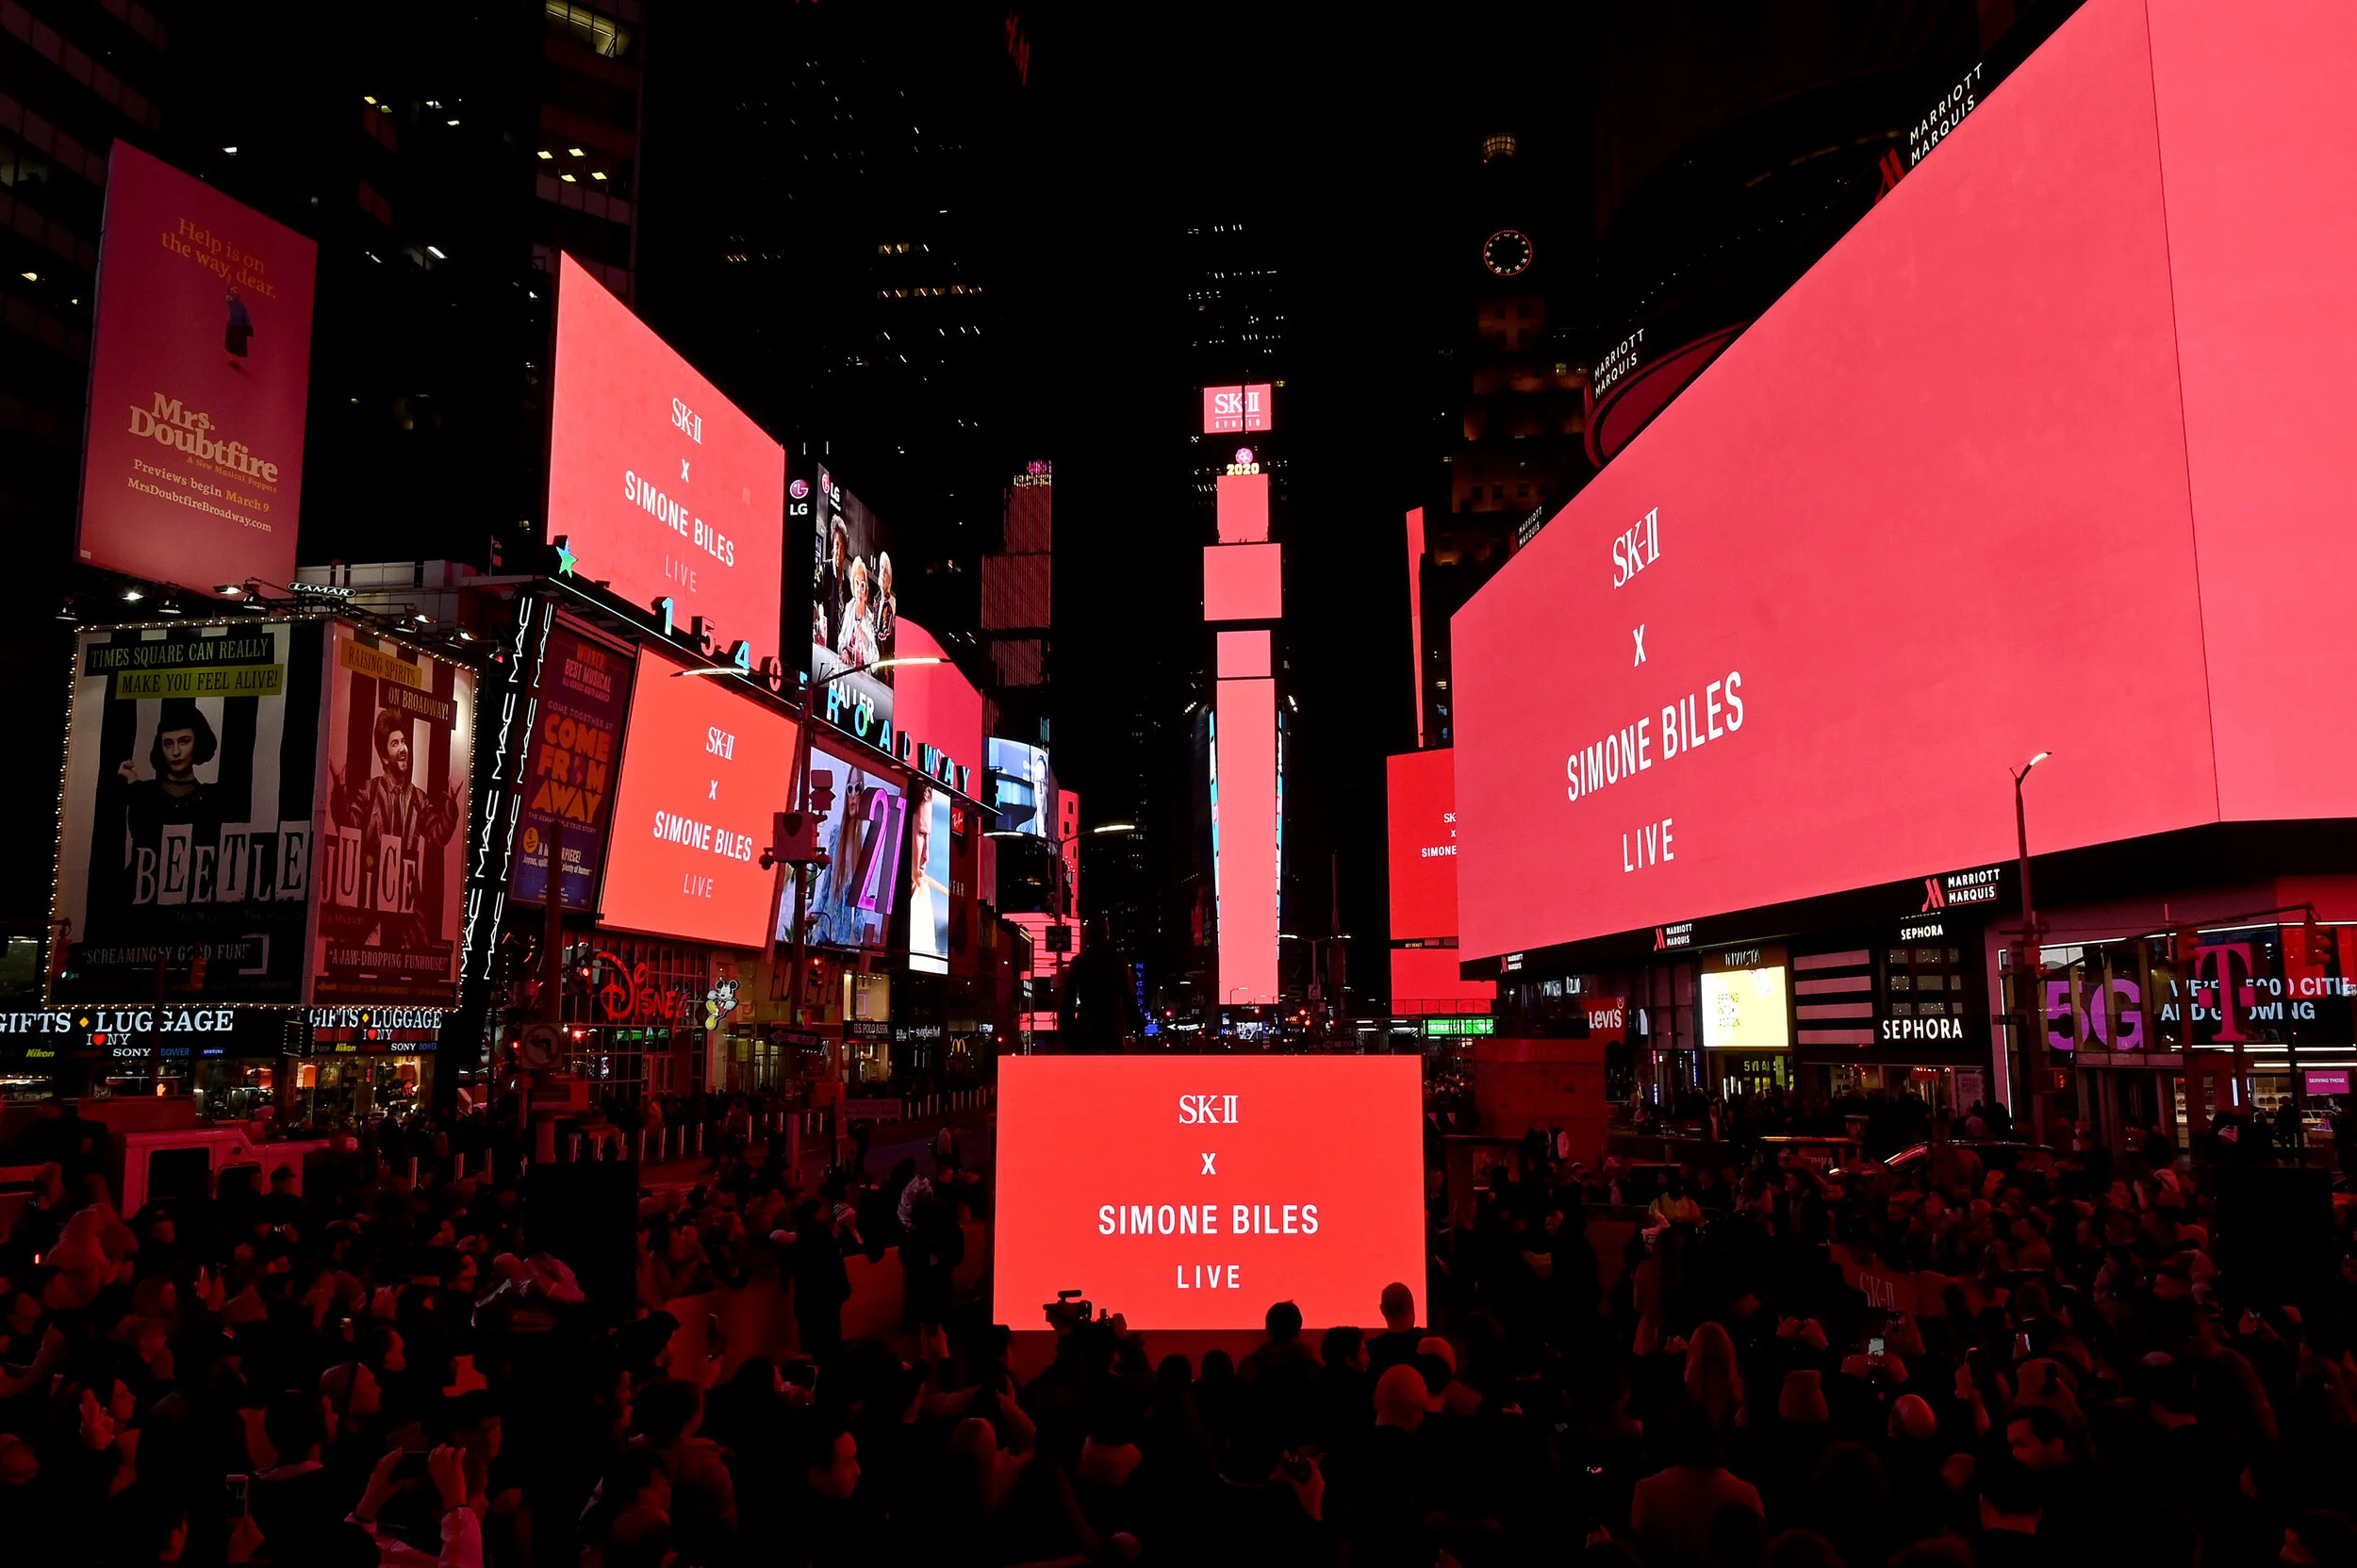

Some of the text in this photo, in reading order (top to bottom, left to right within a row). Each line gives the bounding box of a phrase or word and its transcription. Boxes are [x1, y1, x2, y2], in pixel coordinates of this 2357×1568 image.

[1910, 62, 1983, 146] MARRIOTT
[1911, 94, 1975, 167] MARQUIS
[179, 217, 264, 273] Help is on
[162, 232, 276, 299] the way, dear.
[1594, 328, 1644, 382] MARRIOTT
[1595, 352, 1638, 399] MARQUIS
[152, 391, 215, 431] Mrs.
[1214, 392, 1261, 414] SK-II
[671, 396, 702, 445] SK-II
[128, 405, 279, 483] Doubtfire
[195, 459, 212, 471] New
[1227, 462, 1261, 476] 2020
[133, 458, 271, 513] Previews begin March 9
[830, 482, 840, 503] LG
[126, 476, 272, 533] MrsDoubtfireBroadway.com
[624, 470, 734, 568] SIMONE BILES
[789, 503, 809, 516] LG
[1611, 506, 1661, 590] SK-II
[665, 554, 698, 593] LIVE
[293, 584, 349, 596] LAMAR
[91, 637, 270, 668] TIMES SQUARE CAN REALLY
[348, 646, 417, 686] RAISING SPIRITS
[122, 668, 278, 695] MAKE YOU FEEL ALIVE!
[565, 658, 611, 693] BEST MUSICAL
[387, 687, 450, 720] ON BROADWAY!
[548, 700, 614, 733] COME TOGETHER AT
[544, 713, 612, 764] COME
[705, 726, 735, 761] SK-II
[1566, 670, 1744, 802] SIMONE BILES
[530, 779, 603, 825] AWAY
[652, 810, 752, 863] SIMONE BILES
[856, 788, 908, 916] 21
[1421, 845, 1458, 858] SIMONE
[1623, 817, 1675, 874] LIVE
[133, 828, 306, 905] BEETLE
[321, 830, 418, 915] JUICE
[1948, 868, 2001, 888] MARRIOTT
[683, 873, 714, 899] LIVE
[1948, 885, 1996, 904] MARQUIS
[1666, 922, 1693, 935] MARRIOTT
[1667, 934, 1690, 947] MARQUIS
[1901, 924, 1944, 941] SEPHORA
[176, 943, 213, 962] GOD
[338, 949, 403, 969] JAW-DROPPING
[1724, 949, 1761, 966] INVICTA
[2194, 942, 2256, 1042] T
[2300, 977, 2357, 998] CITIE
[94, 1010, 235, 1033] LUGGAGE
[309, 1008, 443, 1030] GIFTS LUGGAGE
[862, 1023, 876, 1034] POLO
[1882, 1018, 1963, 1039] SEPHORA
[2045, 978, 2144, 1051] 5G
[86, 1033, 132, 1046] I NY
[335, 1042, 357, 1052] Nikon
[376, 1029, 394, 1041] NY
[390, 1042, 417, 1051] SONY
[25, 1048, 56, 1058] Nikon
[113, 1048, 152, 1057] SONY
[160, 1048, 190, 1057] BOWER
[1178, 1094, 1240, 1125] SK-II
[1098, 1204, 1320, 1235] SIMONE BILES
[1177, 1264, 1241, 1289] LIVE
